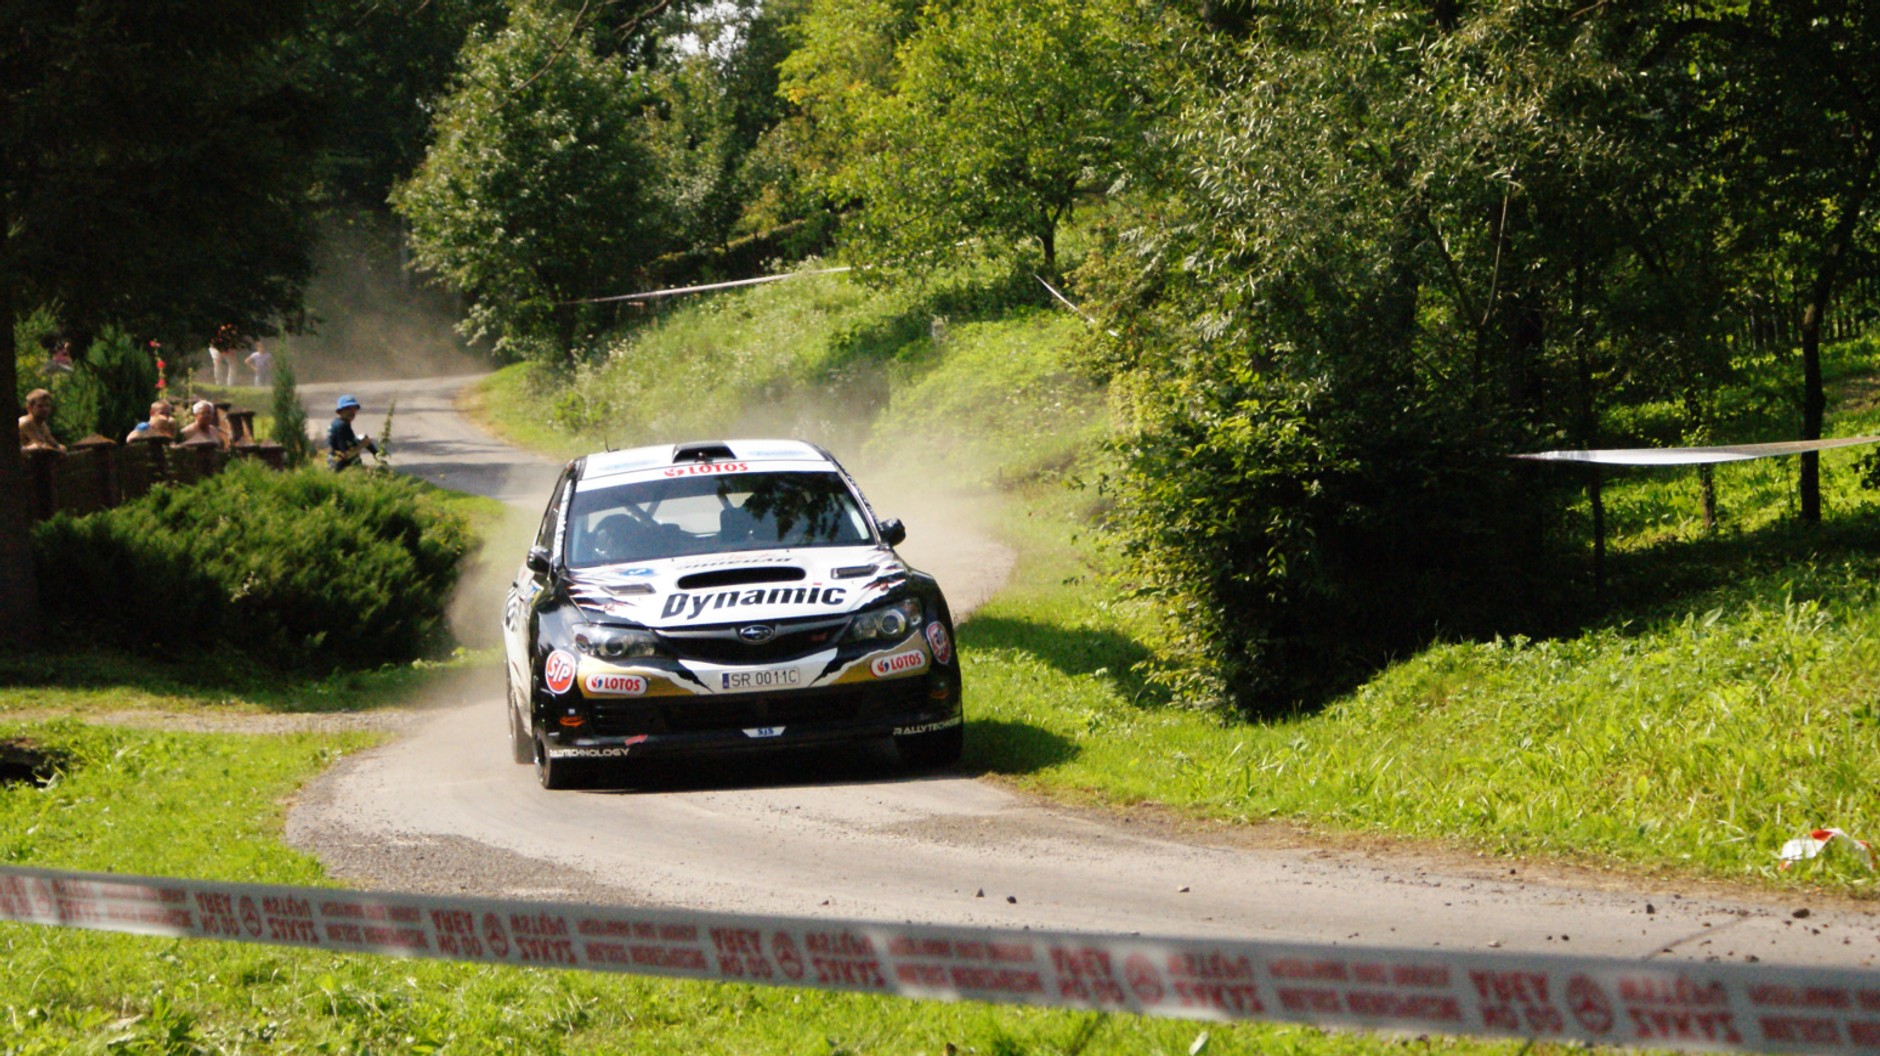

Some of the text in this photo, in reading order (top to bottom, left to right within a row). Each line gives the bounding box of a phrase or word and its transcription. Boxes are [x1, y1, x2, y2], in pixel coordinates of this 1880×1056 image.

[689, 463, 748, 475] LOTOS
[660, 582, 847, 620] Dynamic
[547, 656, 571, 683] STP
[891, 652, 922, 670] LOTOS
[604, 677, 641, 692] LOTOS
[731, 669, 797, 687] SR 0011C
